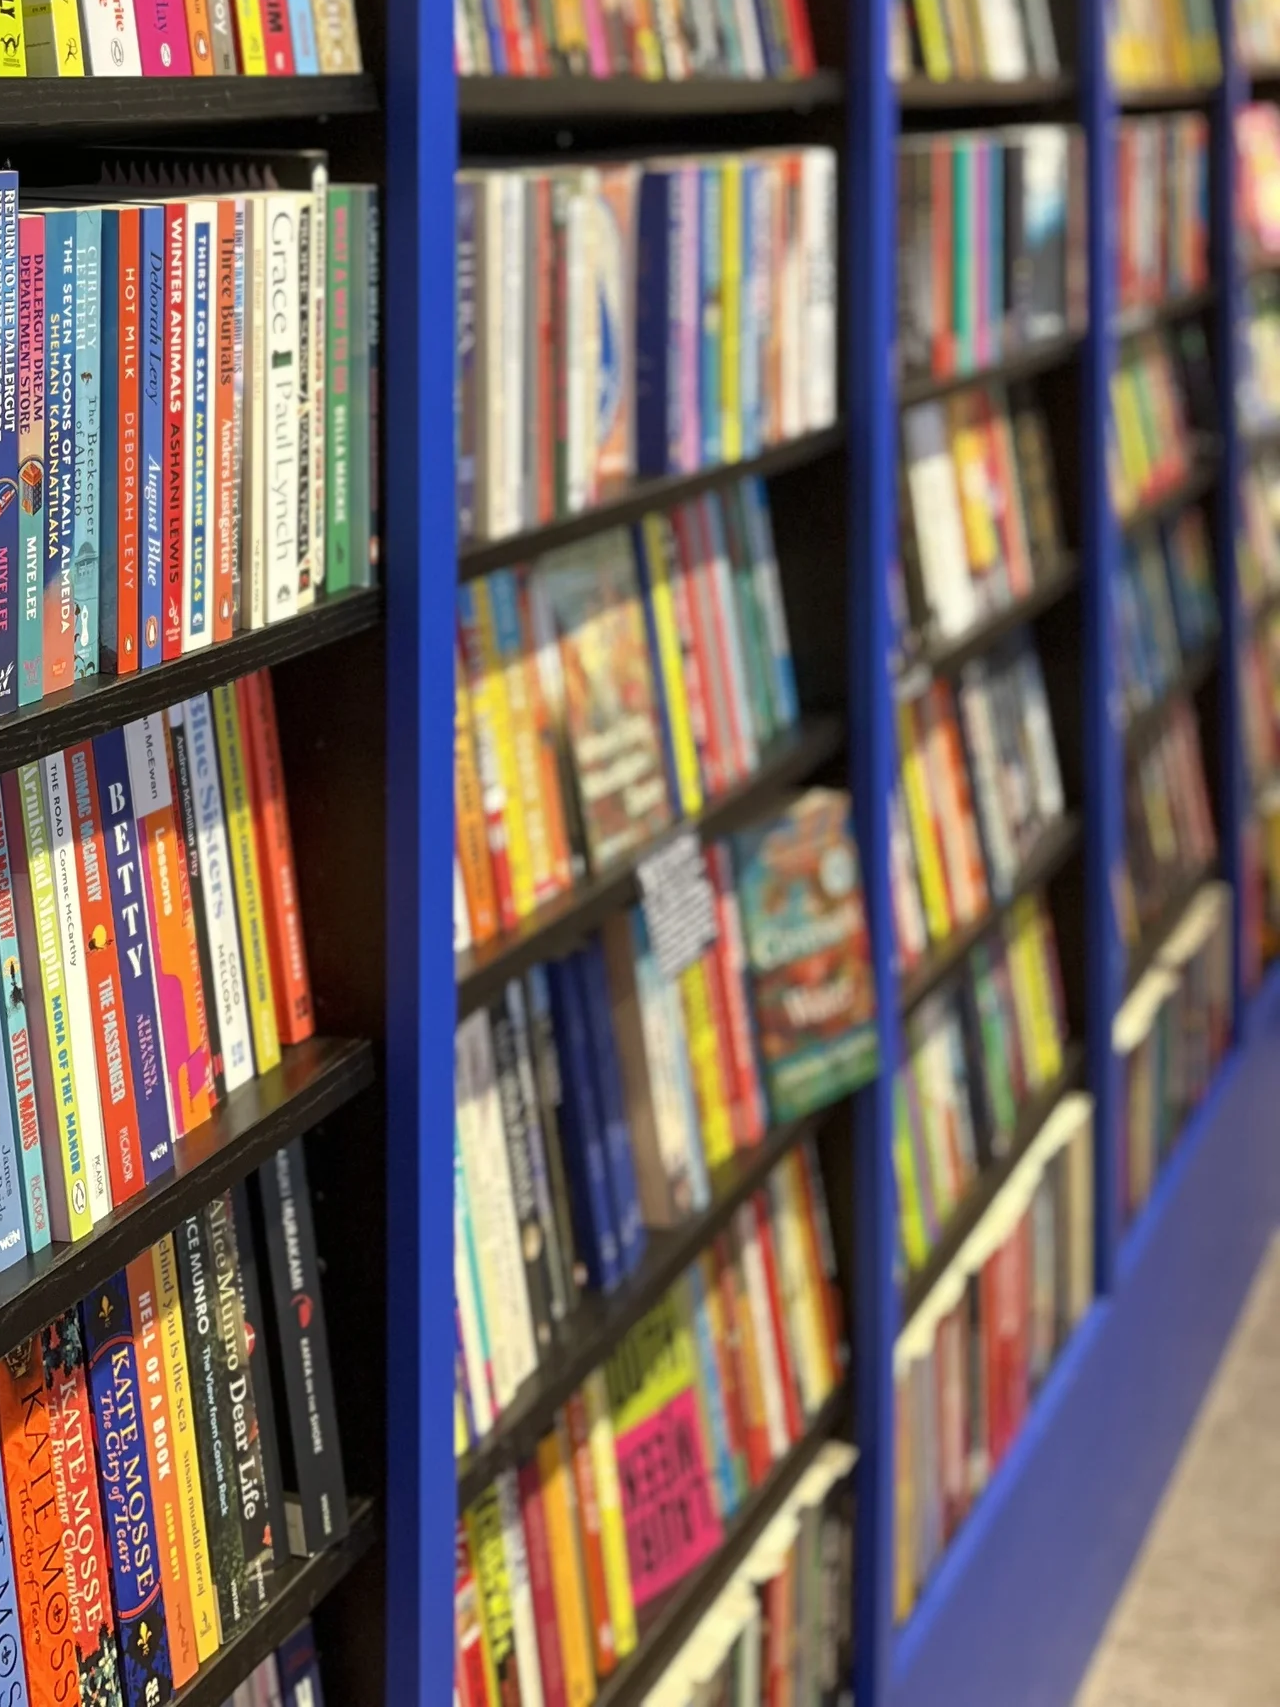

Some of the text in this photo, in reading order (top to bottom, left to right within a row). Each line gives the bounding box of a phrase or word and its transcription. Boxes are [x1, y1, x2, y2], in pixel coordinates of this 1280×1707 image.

[124, 267, 135, 382] HOT MILK
[124, 412, 135, 589] DEBORAH LEVY
[108, 784, 143, 979] BETTY
[111, 1347, 158, 1597] KATE MOSSE
[138, 1291, 172, 1481] HELL OF A BOOK
